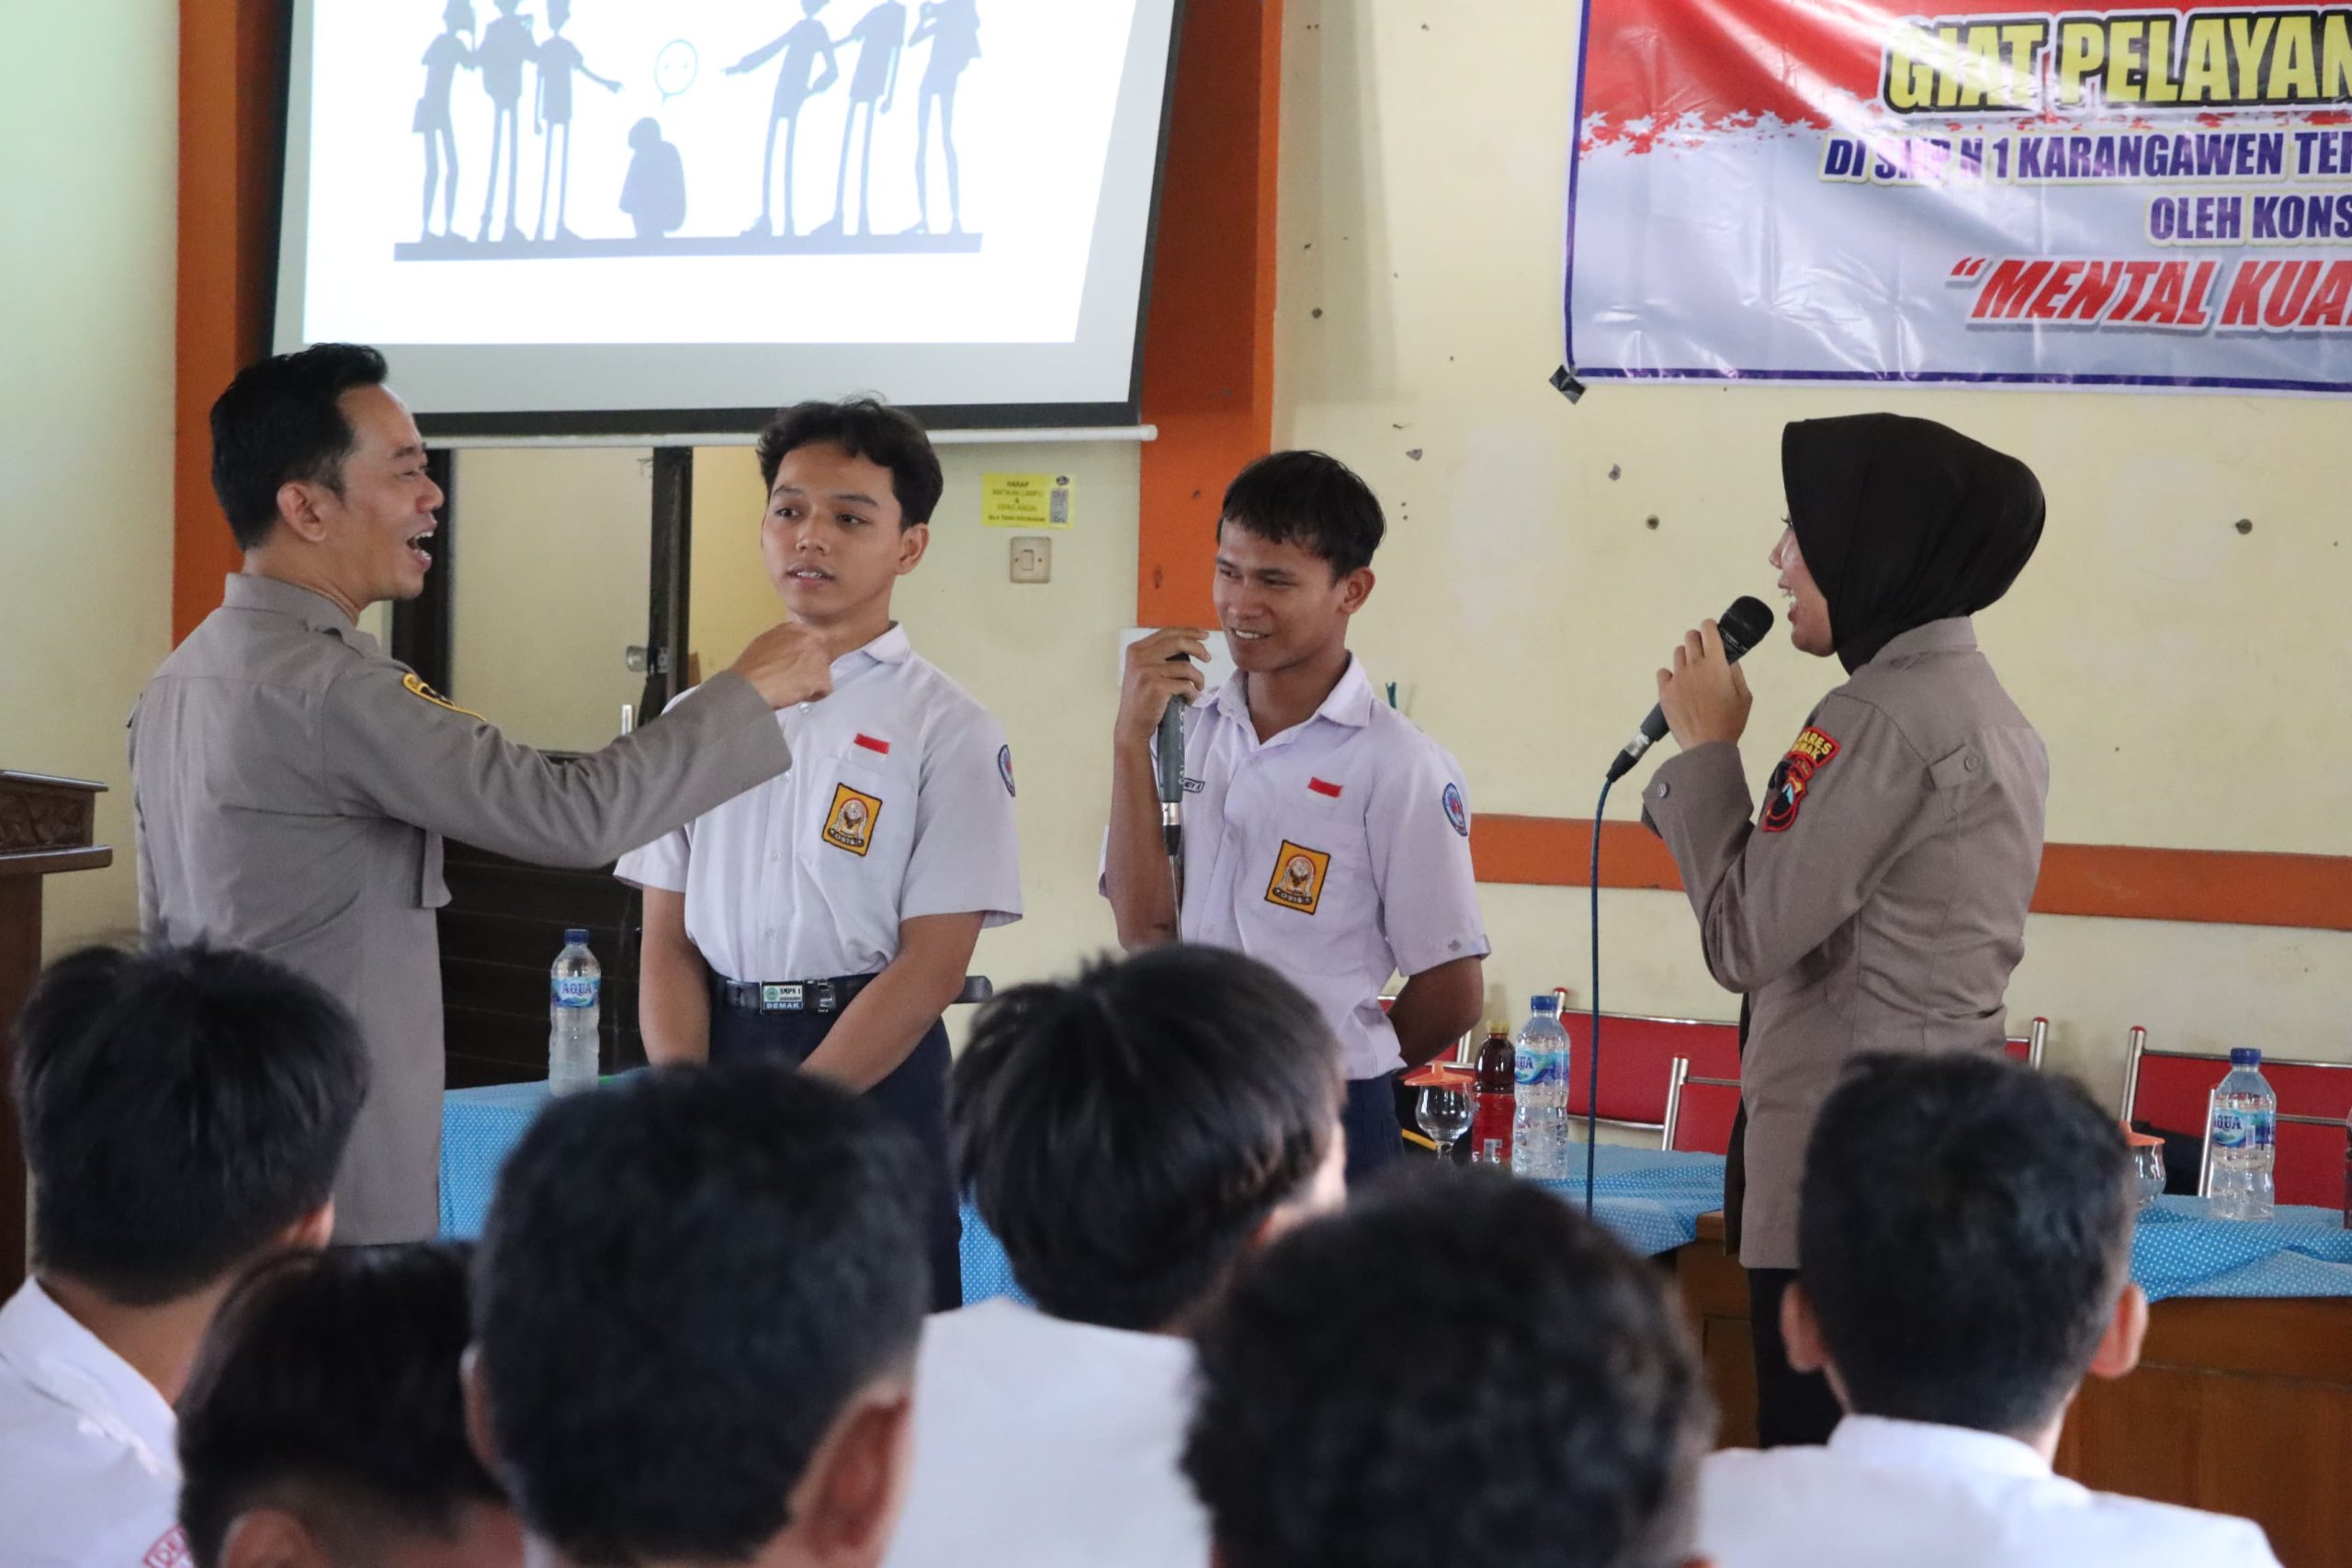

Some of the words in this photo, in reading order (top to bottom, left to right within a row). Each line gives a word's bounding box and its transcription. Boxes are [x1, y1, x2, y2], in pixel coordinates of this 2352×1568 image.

[1886, 22, 2048, 110] GIAT
[2059, 15, 2352, 105] PELAYAN
[1825, 140, 1866, 176] DI
[1874, 138, 1951, 179] SP
[1960, 137, 1983, 177] N
[1993, 138, 2009, 177] 1
[2018, 133, 2284, 177] KARANGAWEN
[2150, 196, 2242, 240] OLEH
[2252, 195, 2352, 239] KONS
[2220, 260, 2352, 327] KUA
[561, 983, 593, 996] AQUA
[1515, 1056, 1534, 1070] UA
